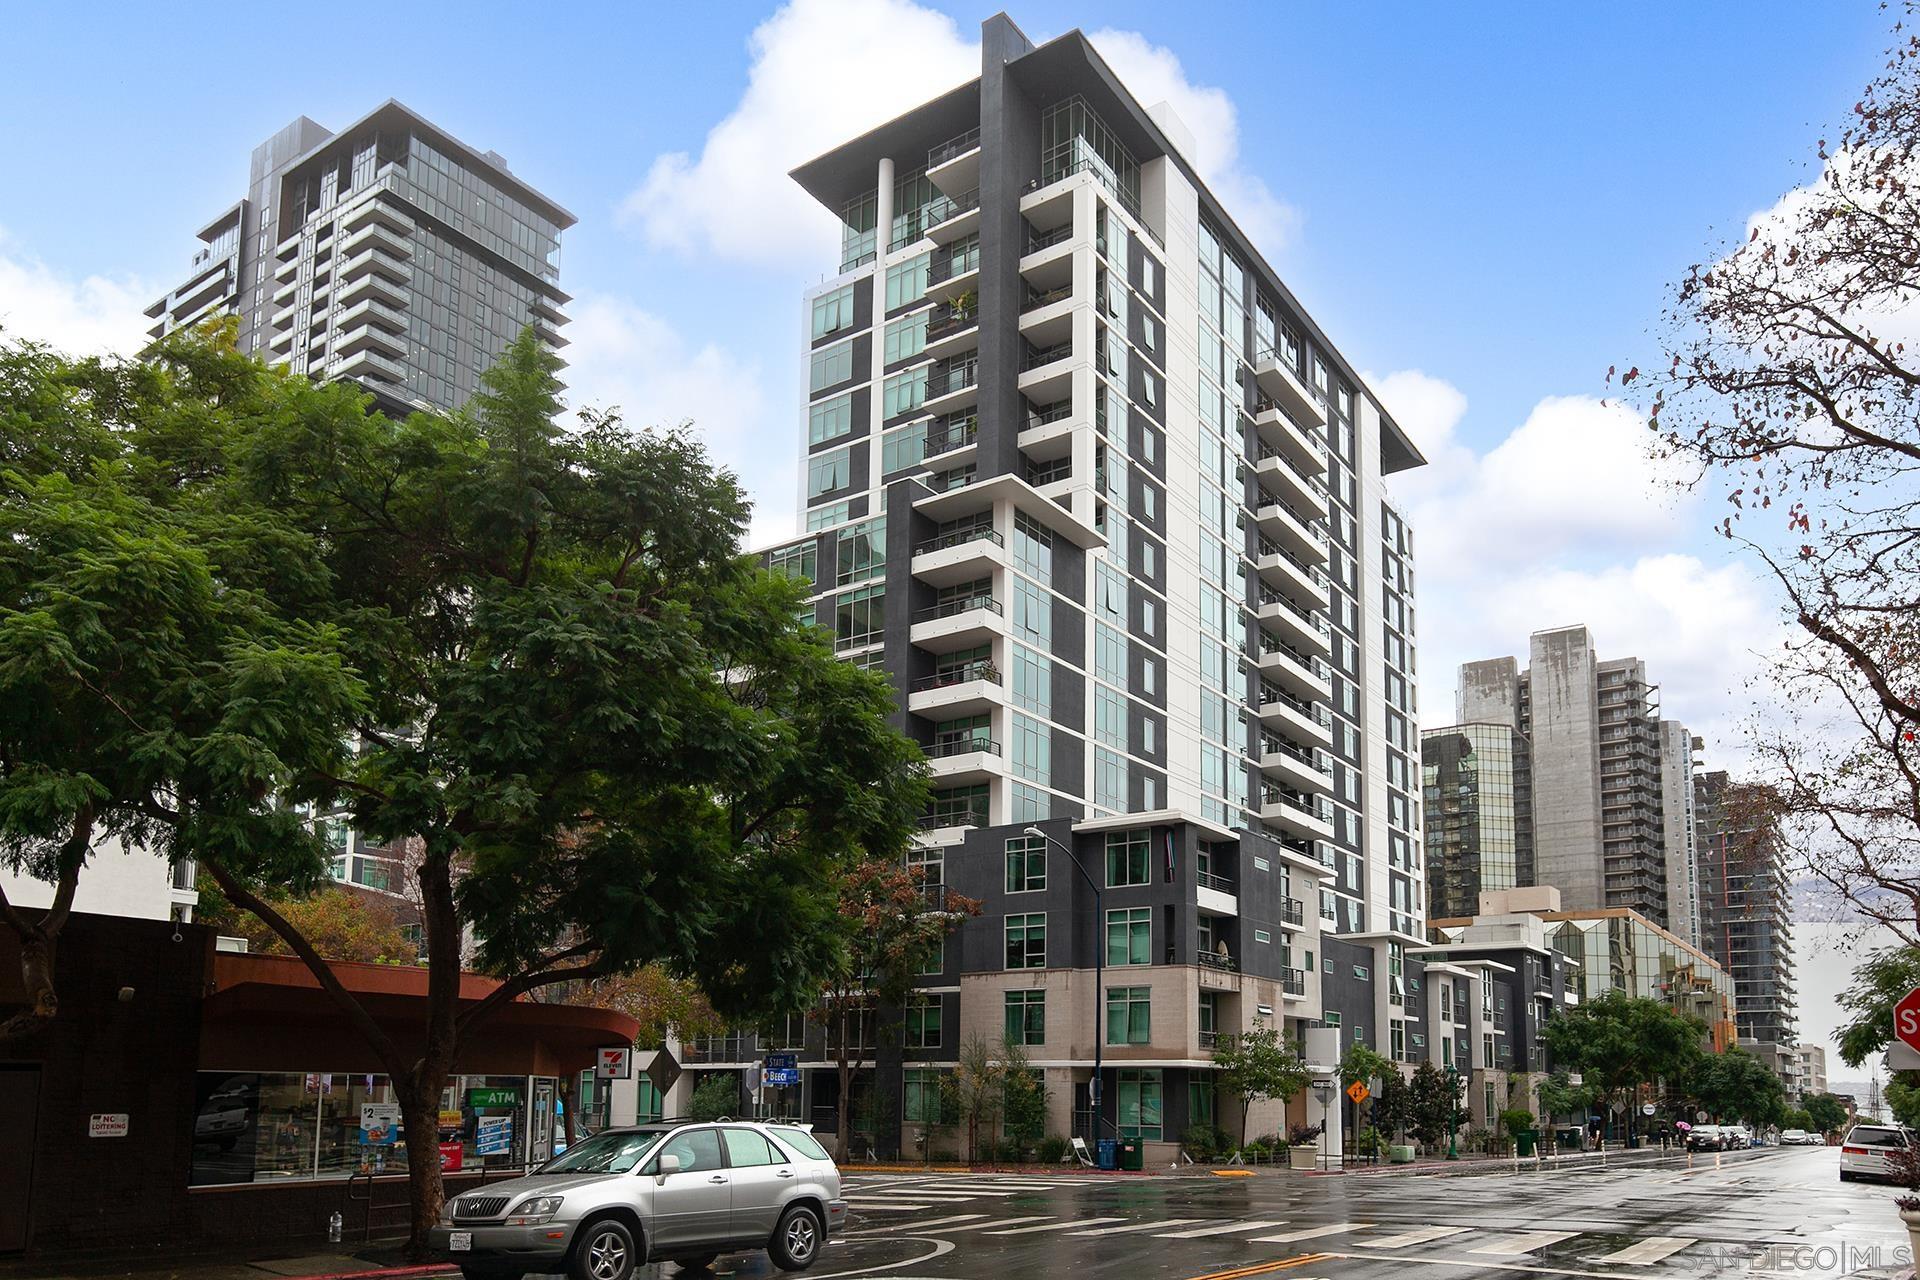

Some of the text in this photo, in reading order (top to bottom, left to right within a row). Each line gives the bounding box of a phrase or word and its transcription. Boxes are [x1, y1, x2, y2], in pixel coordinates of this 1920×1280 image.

[1901, 1008, 1920, 1035] S
[769, 1057, 785, 1067] STATE
[488, 1092, 516, 1104] ATM
[363, 1107, 374, 1119] $2
